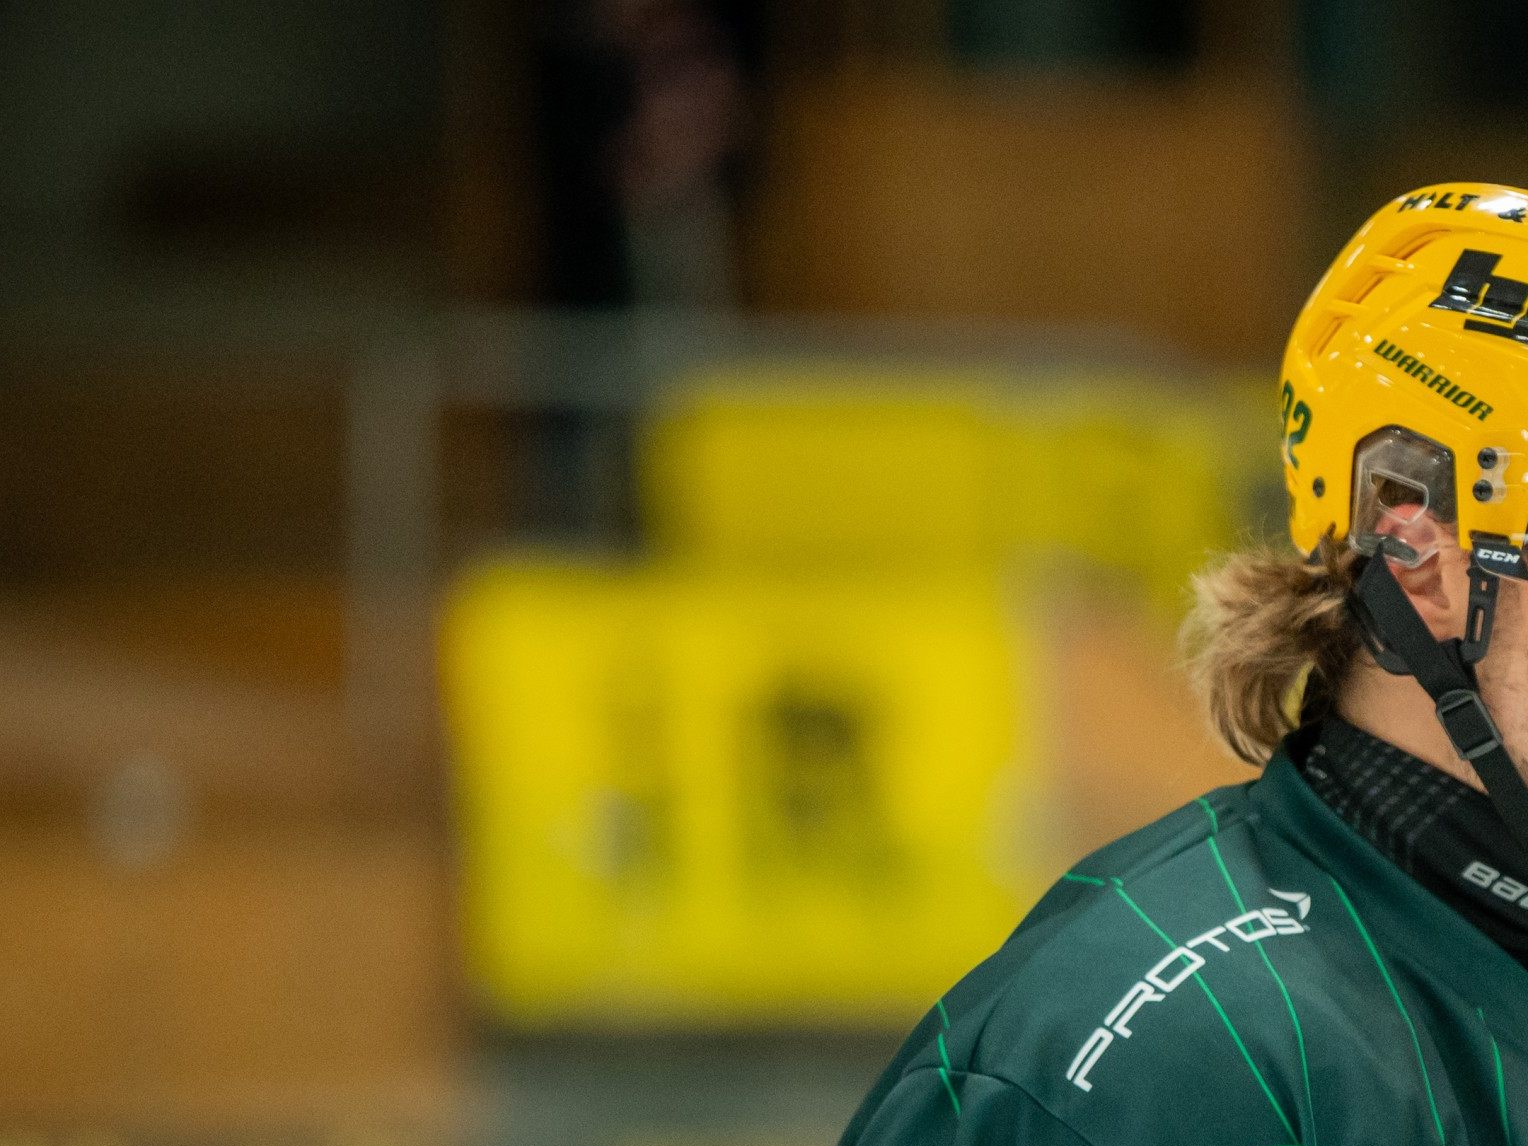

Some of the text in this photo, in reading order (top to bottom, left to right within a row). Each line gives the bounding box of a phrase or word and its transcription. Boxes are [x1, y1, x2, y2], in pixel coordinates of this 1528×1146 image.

[1373, 339, 1494, 423] WARRIOR
[1476, 547, 1521, 565] CCM
[1065, 907, 1305, 1093] PROTOS
